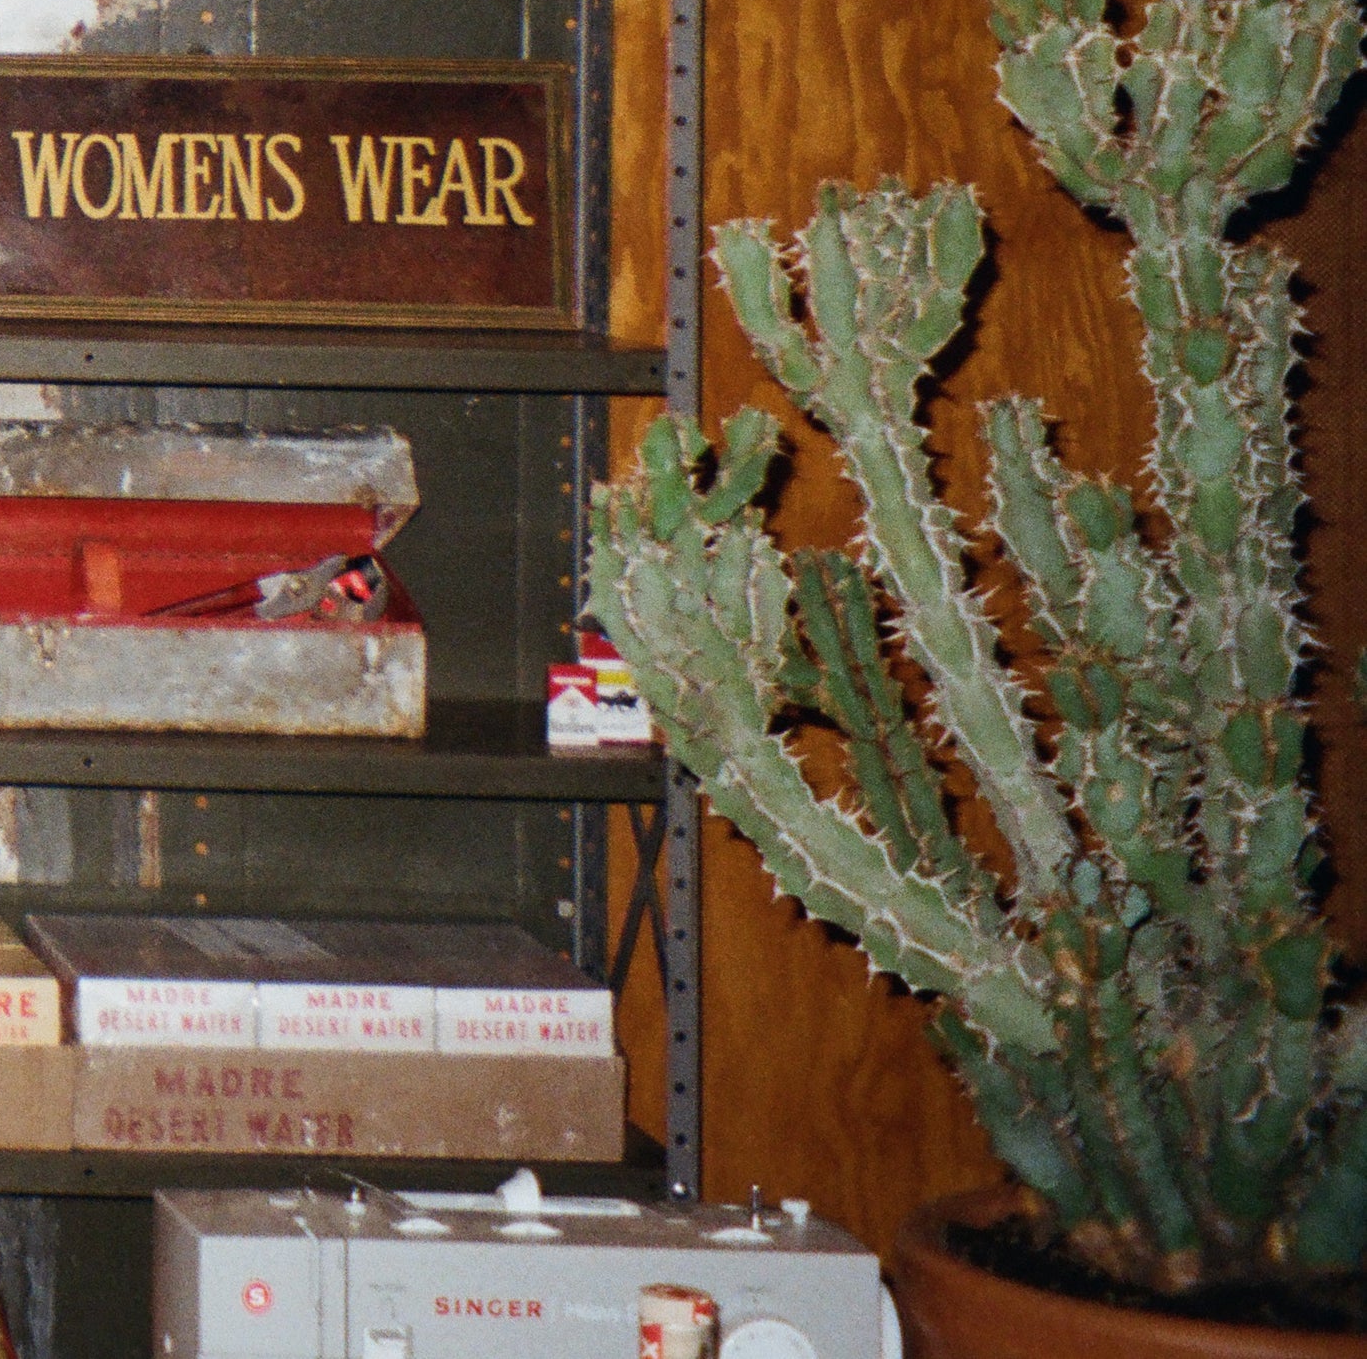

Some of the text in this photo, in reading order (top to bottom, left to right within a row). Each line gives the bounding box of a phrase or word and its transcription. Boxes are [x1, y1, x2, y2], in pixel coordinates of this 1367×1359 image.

[11, 130, 535, 227] WOMENS WEAR
[126, 985, 211, 1006] MADRE
[306, 989, 393, 1012] MADRE
[483, 995, 571, 1015] MADRE
[278, 1014, 423, 1039] DESERT WATER
[456, 1018, 601, 1043] DESERT WATER
[153, 1066, 303, 1100] MADRE
[103, 1106, 355, 1147] DESERT WATER
[435, 1297, 544, 1319] SINGER
